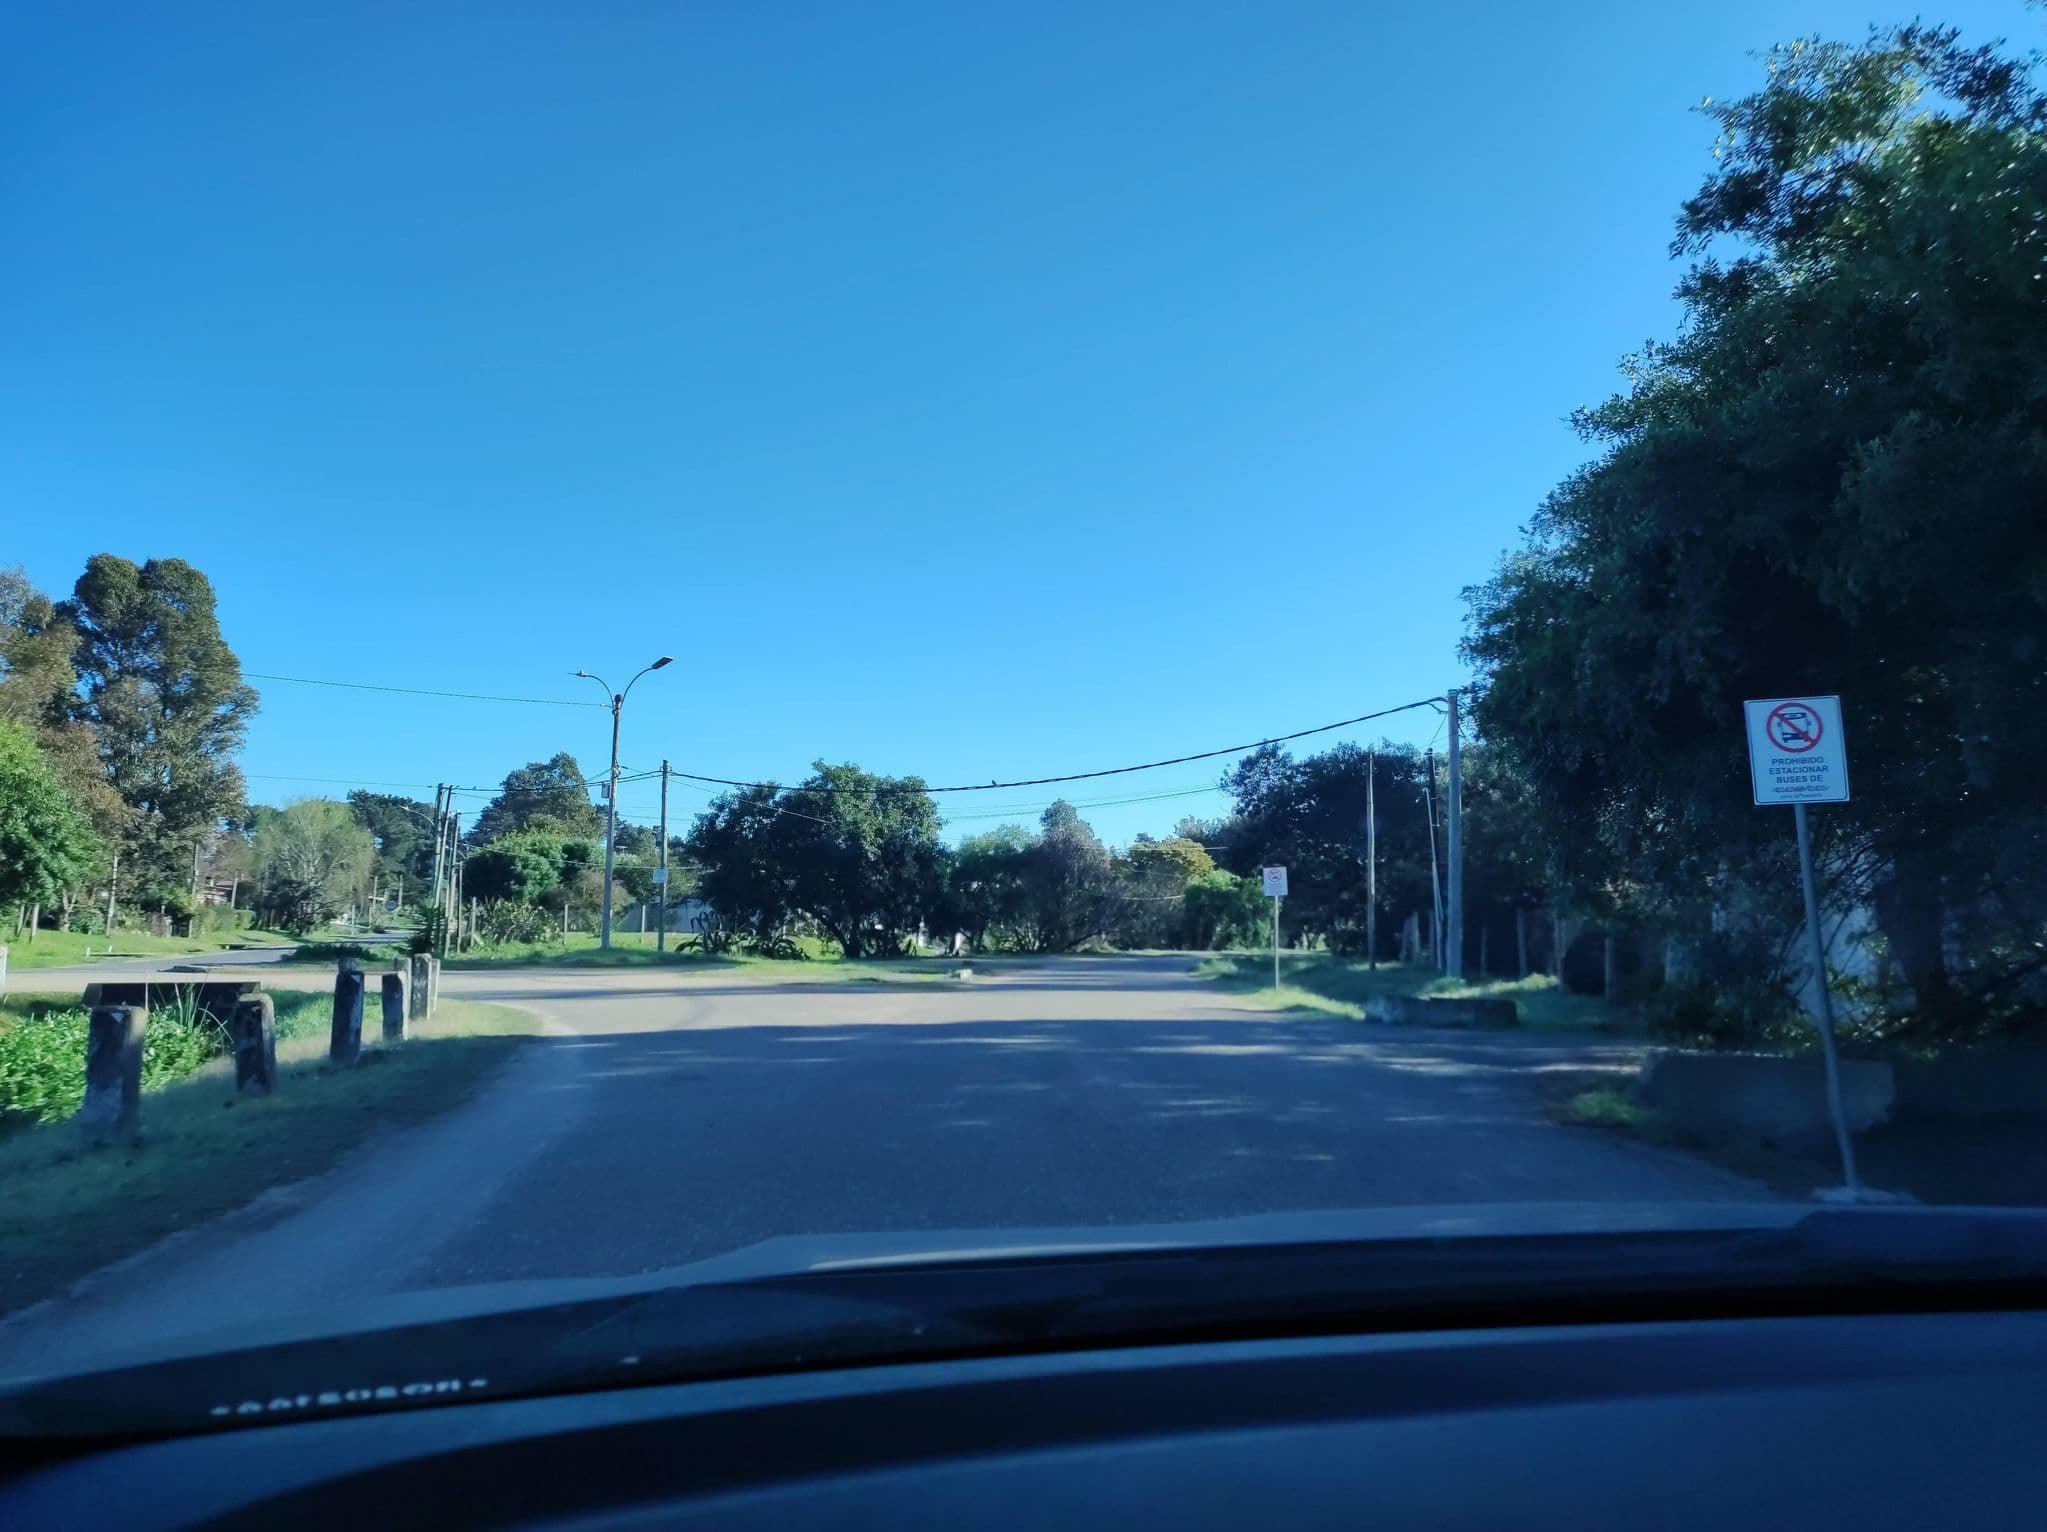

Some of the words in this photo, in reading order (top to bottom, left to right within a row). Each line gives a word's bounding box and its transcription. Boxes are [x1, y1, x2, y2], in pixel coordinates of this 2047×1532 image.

[1771, 756, 1825, 766] PROHIBIDO
[1768, 765, 1830, 775] ESTACIONAR
[1775, 775, 1808, 784] BUSES
[1810, 774, 1824, 782] DE
